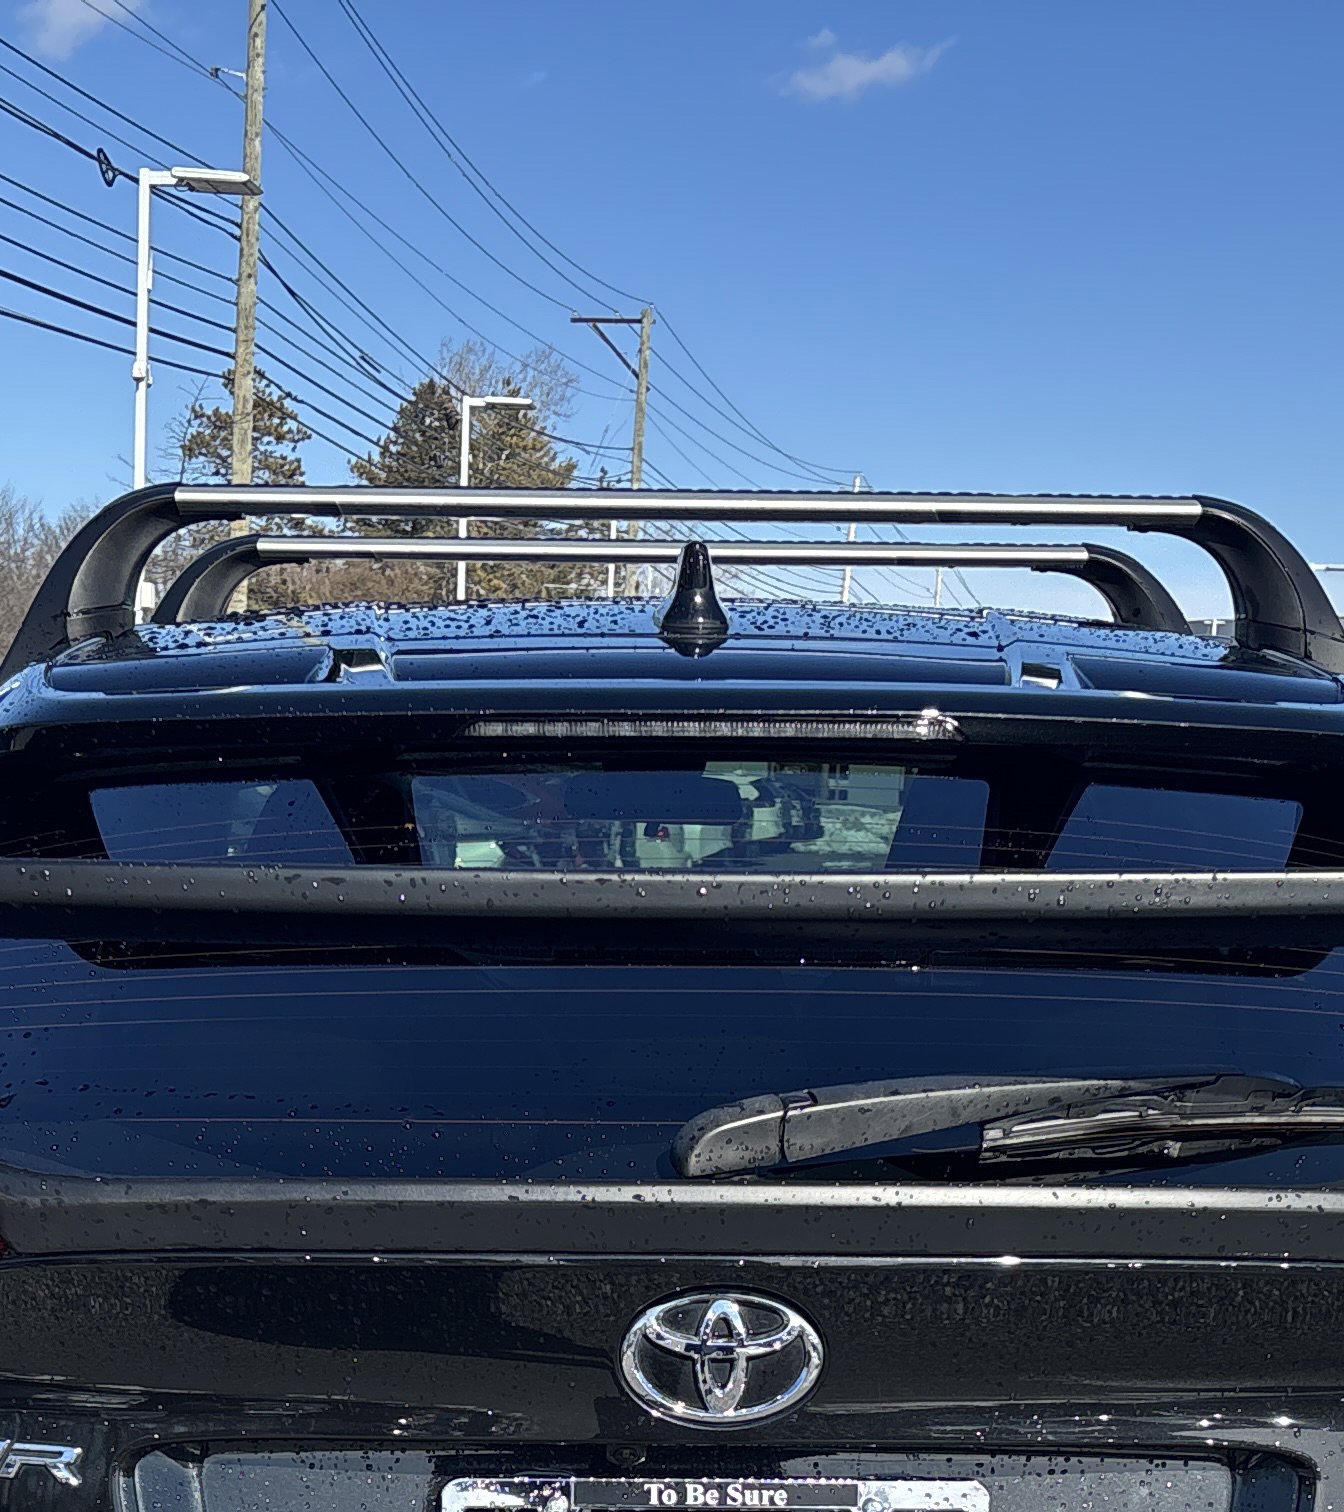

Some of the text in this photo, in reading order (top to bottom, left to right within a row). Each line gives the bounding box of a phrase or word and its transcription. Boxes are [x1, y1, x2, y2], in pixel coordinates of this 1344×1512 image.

[644, 1483, 788, 1506] To Be Sure
